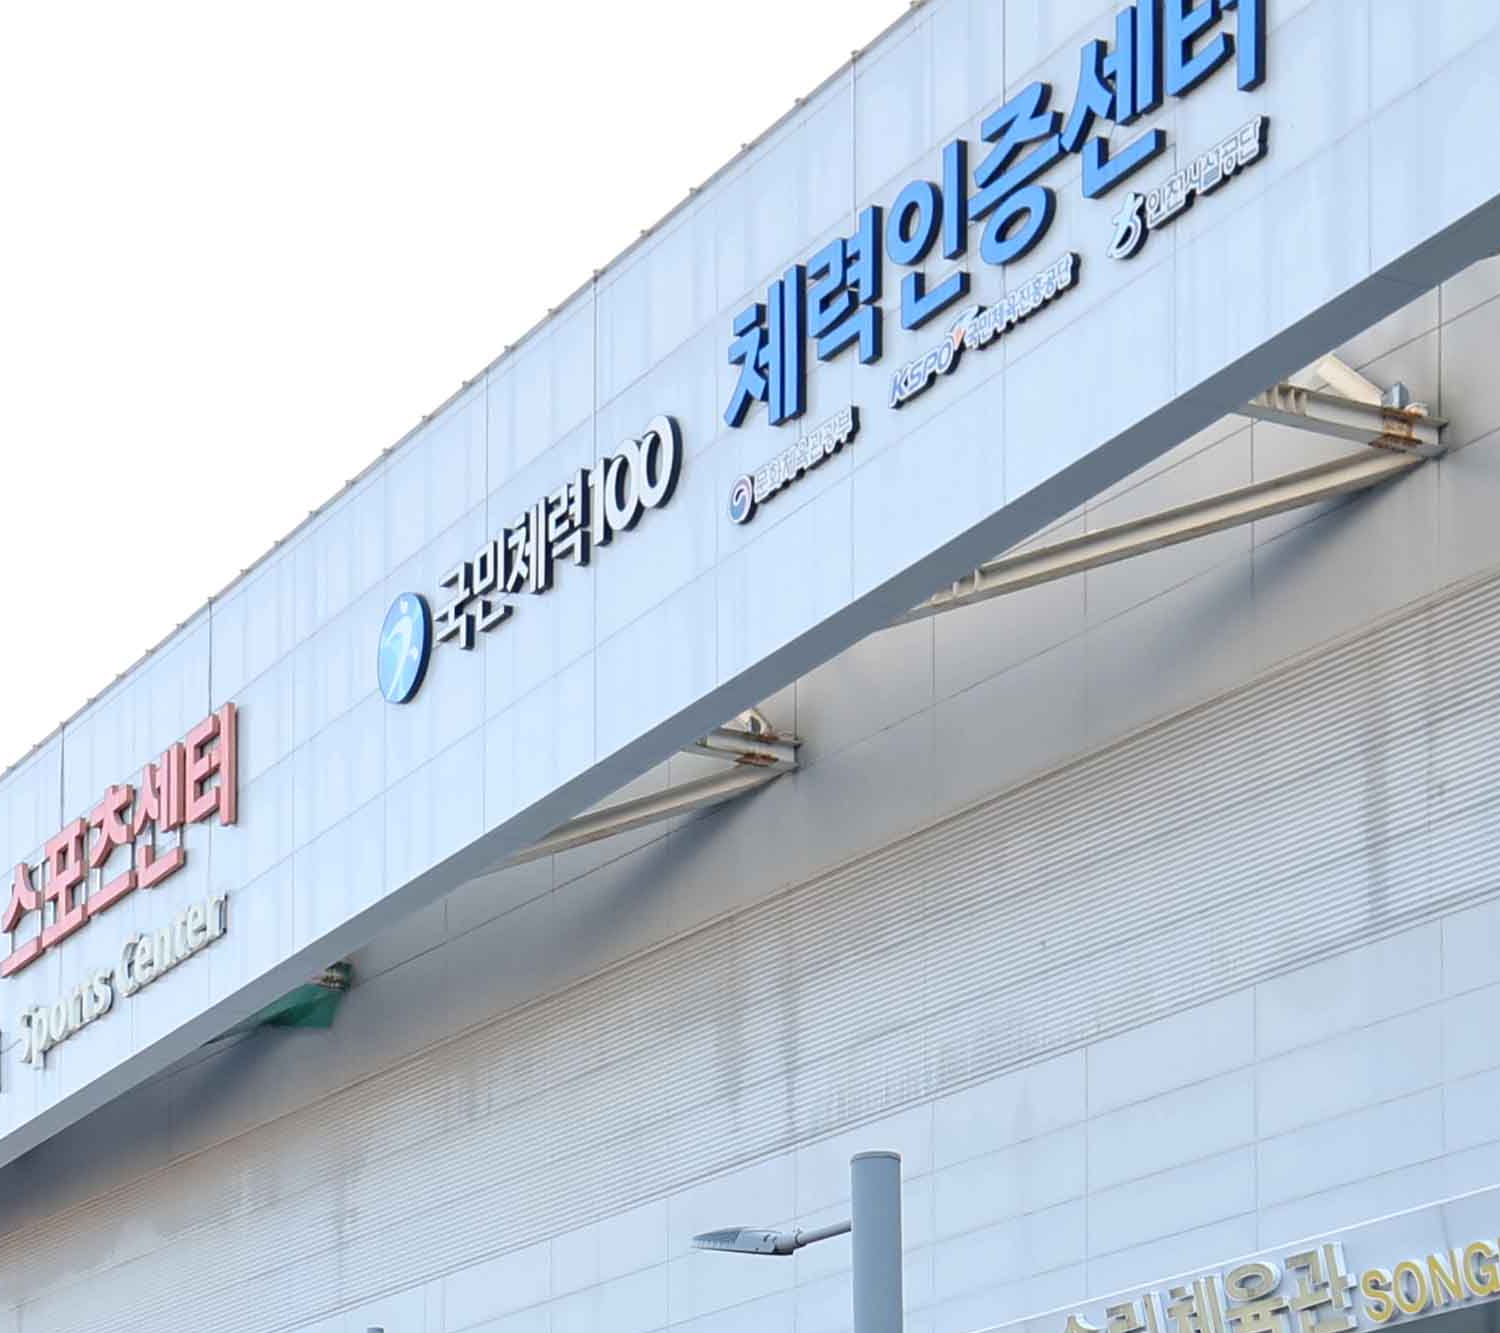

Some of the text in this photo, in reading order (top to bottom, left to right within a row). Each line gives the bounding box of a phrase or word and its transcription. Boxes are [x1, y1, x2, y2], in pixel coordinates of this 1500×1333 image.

[1146, 115, 1269, 229] 인천시설공단
[889, 335, 958, 409] KSPO
[1, 702, 239, 978] 스포츠센터
[18, 969, 114, 1070] Sports
[119, 889, 231, 998] Center
